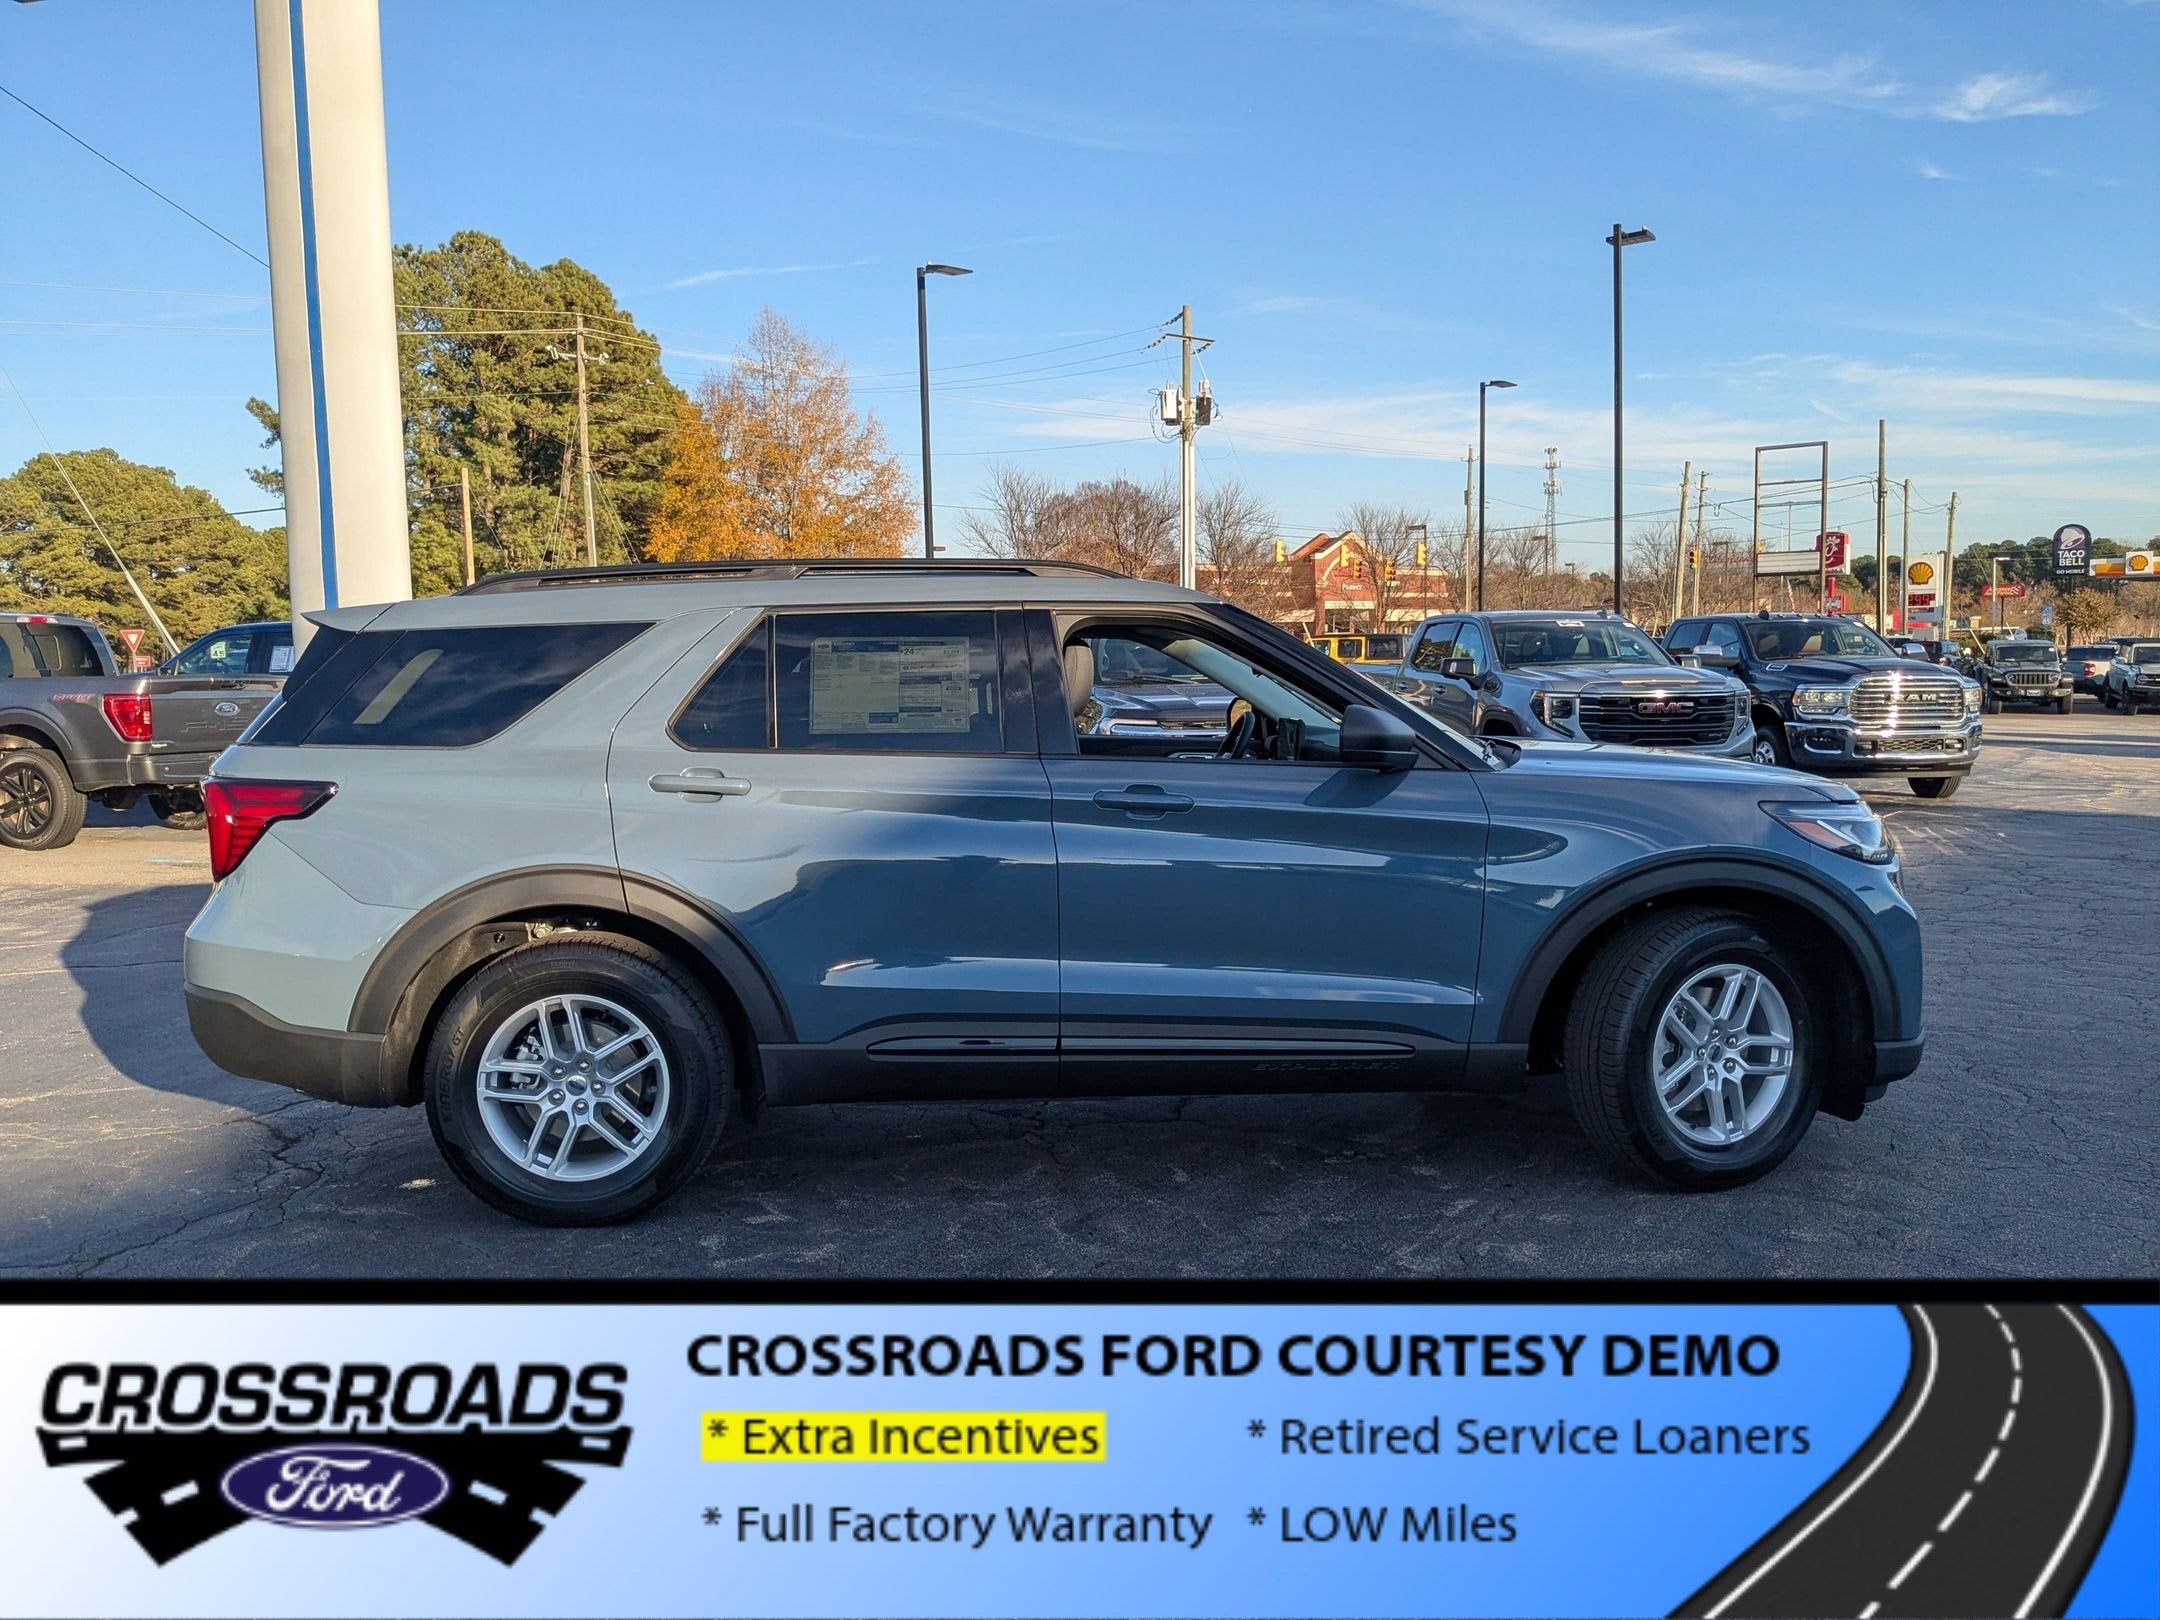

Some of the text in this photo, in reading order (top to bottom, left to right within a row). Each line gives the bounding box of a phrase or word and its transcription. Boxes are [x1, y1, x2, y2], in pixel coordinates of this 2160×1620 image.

[2058, 550, 2085, 558] TACO
[2059, 558, 2084, 566] BELL
[1890, 693, 1937, 702] RAM
[1637, 702, 1695, 713] GMC
[1248, 1061, 1401, 1072] EXPLORER
